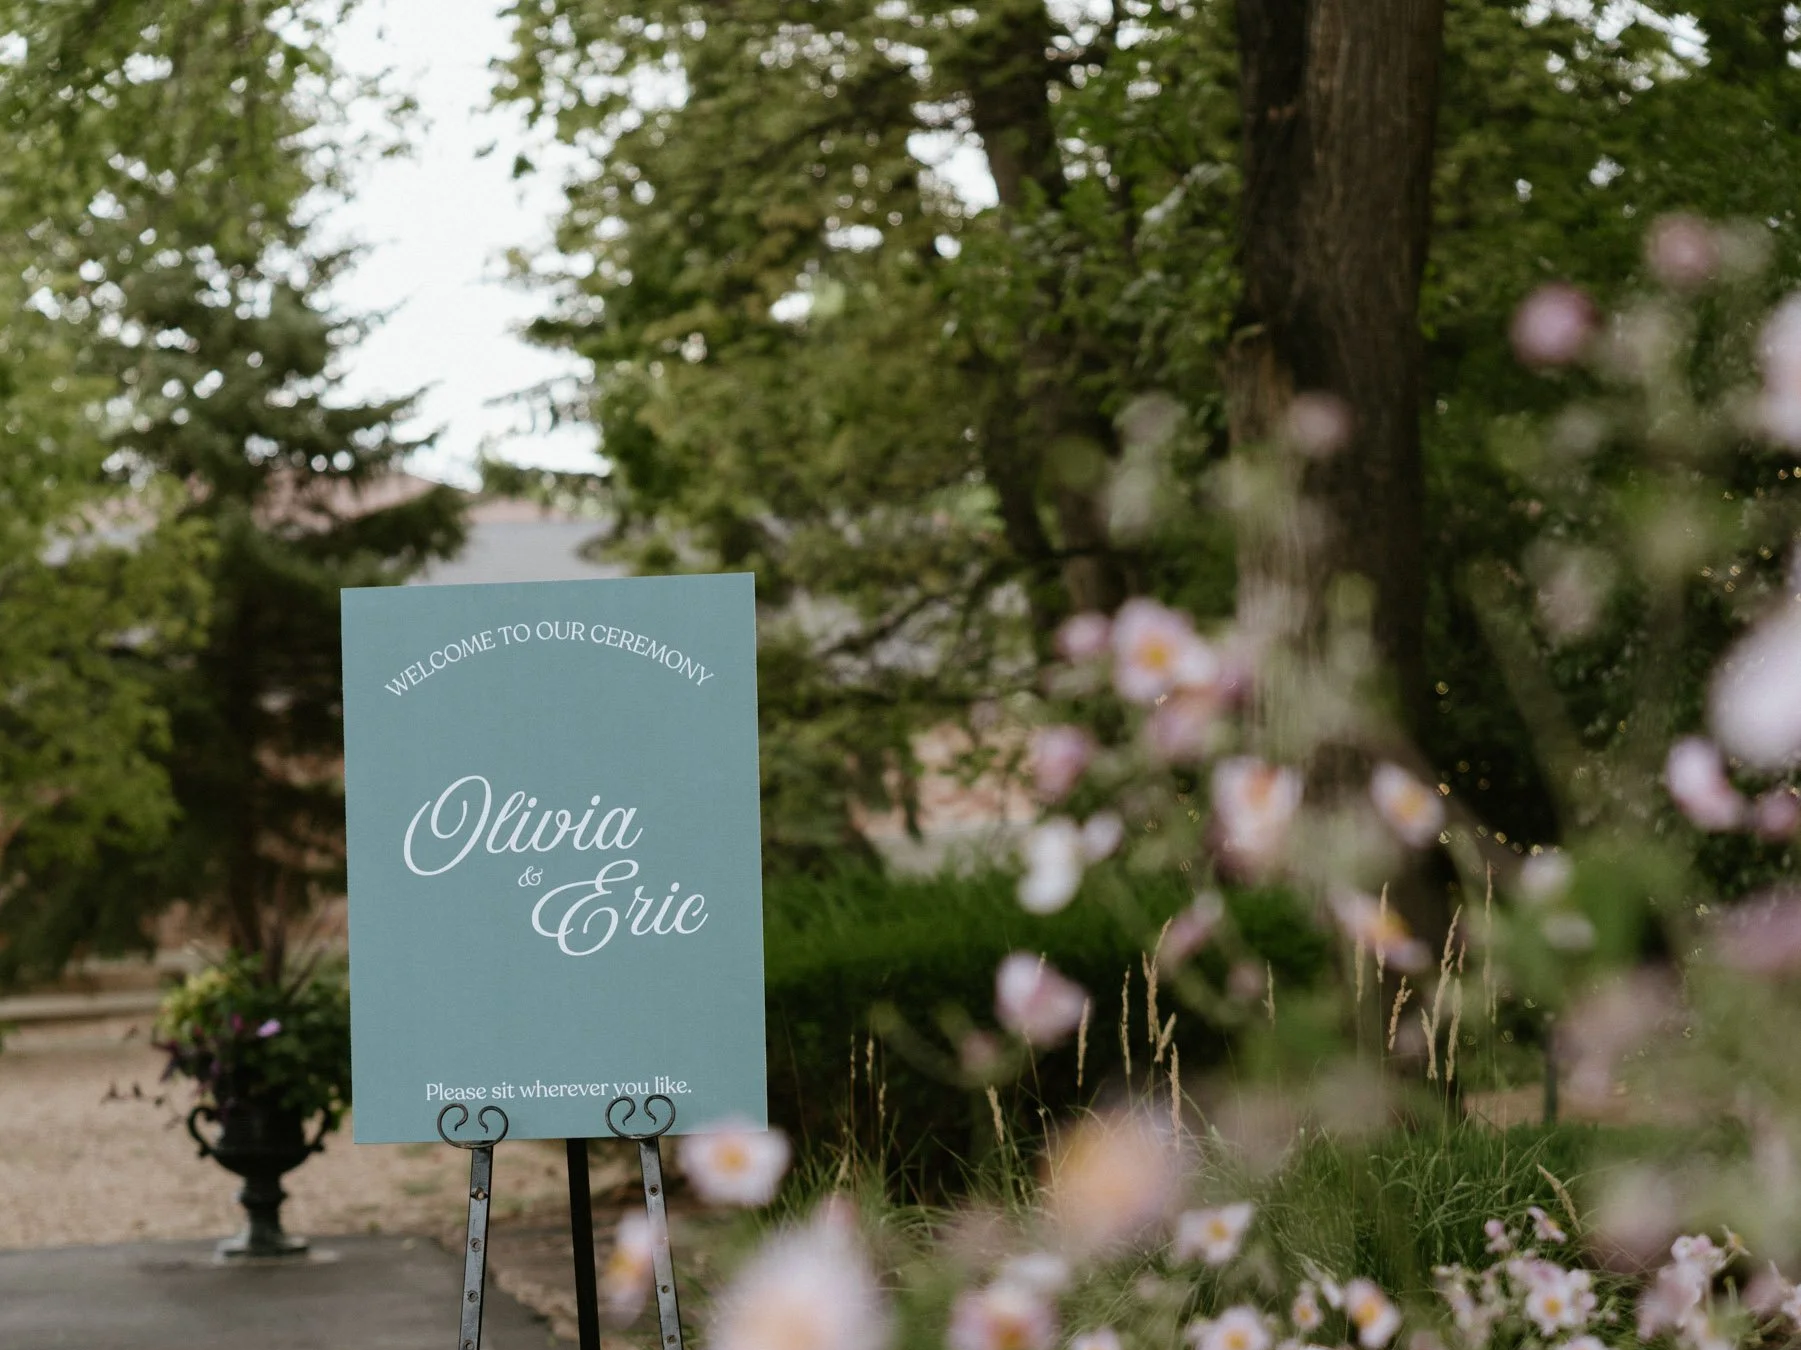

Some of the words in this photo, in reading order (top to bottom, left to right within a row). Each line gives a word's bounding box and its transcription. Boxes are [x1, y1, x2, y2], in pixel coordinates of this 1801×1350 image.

[384, 631, 496, 697] WELCOME
[498, 623, 531, 645] TO
[536, 621, 585, 641] OUR
[590, 624, 714, 687] CEREMONY
[403, 775, 643, 876] Olivia
[518, 866, 543, 887] &
[531, 859, 709, 957] Eric
[426, 1083, 487, 1101] Please
[491, 1081, 515, 1099] sit
[519, 1079, 609, 1098] wherever
[612, 1081, 650, 1099] you
[654, 1075, 692, 1094] like.
